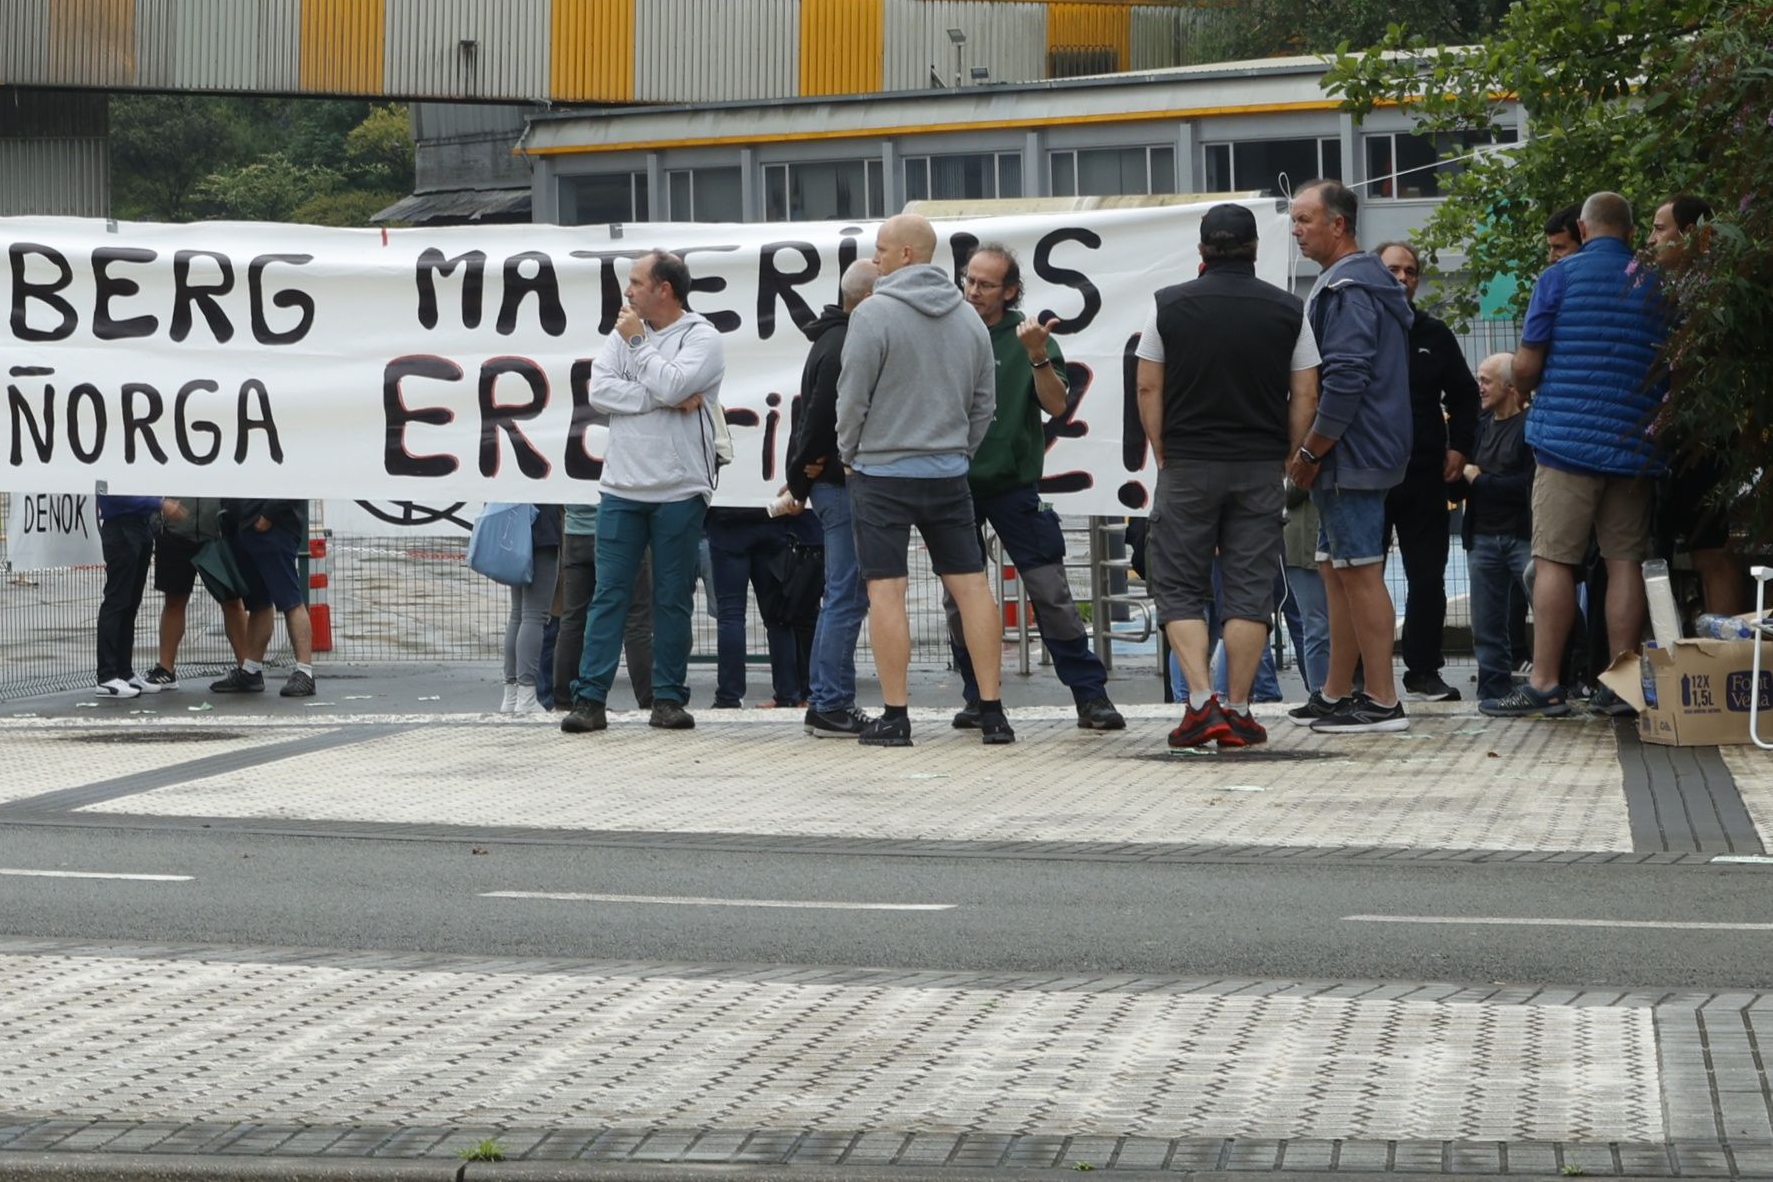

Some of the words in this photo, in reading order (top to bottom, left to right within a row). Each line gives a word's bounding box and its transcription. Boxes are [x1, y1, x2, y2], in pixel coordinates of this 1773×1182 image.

[415, 226, 1103, 342] MATERiS
[23, 493, 88, 539] DENOK
[1692, 675, 1710, 688] 12X
[1692, 690, 1714, 708] 1,5L
[1731, 692, 1771, 707] Vela
